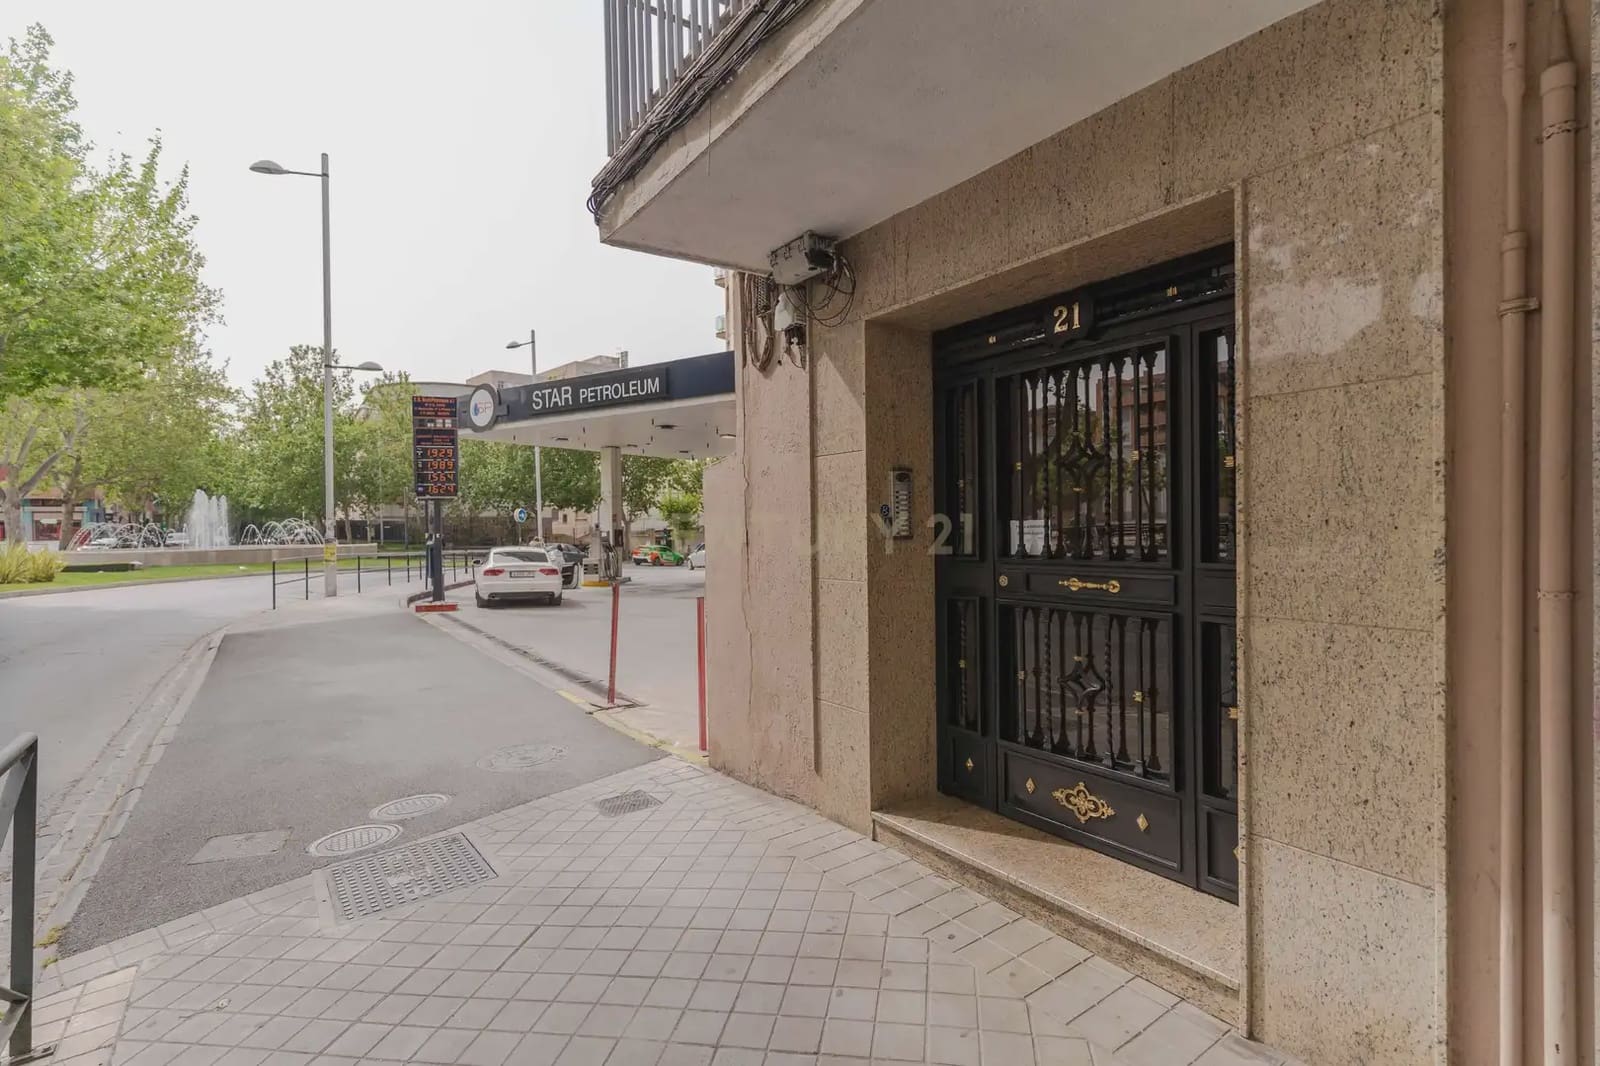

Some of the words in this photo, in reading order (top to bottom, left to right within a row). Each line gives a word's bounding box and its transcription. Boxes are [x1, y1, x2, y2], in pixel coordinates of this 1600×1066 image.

[1054, 302, 1080, 333] 21
[532, 386, 573, 410] STAR
[579, 377, 660, 404] PETROLEUM
